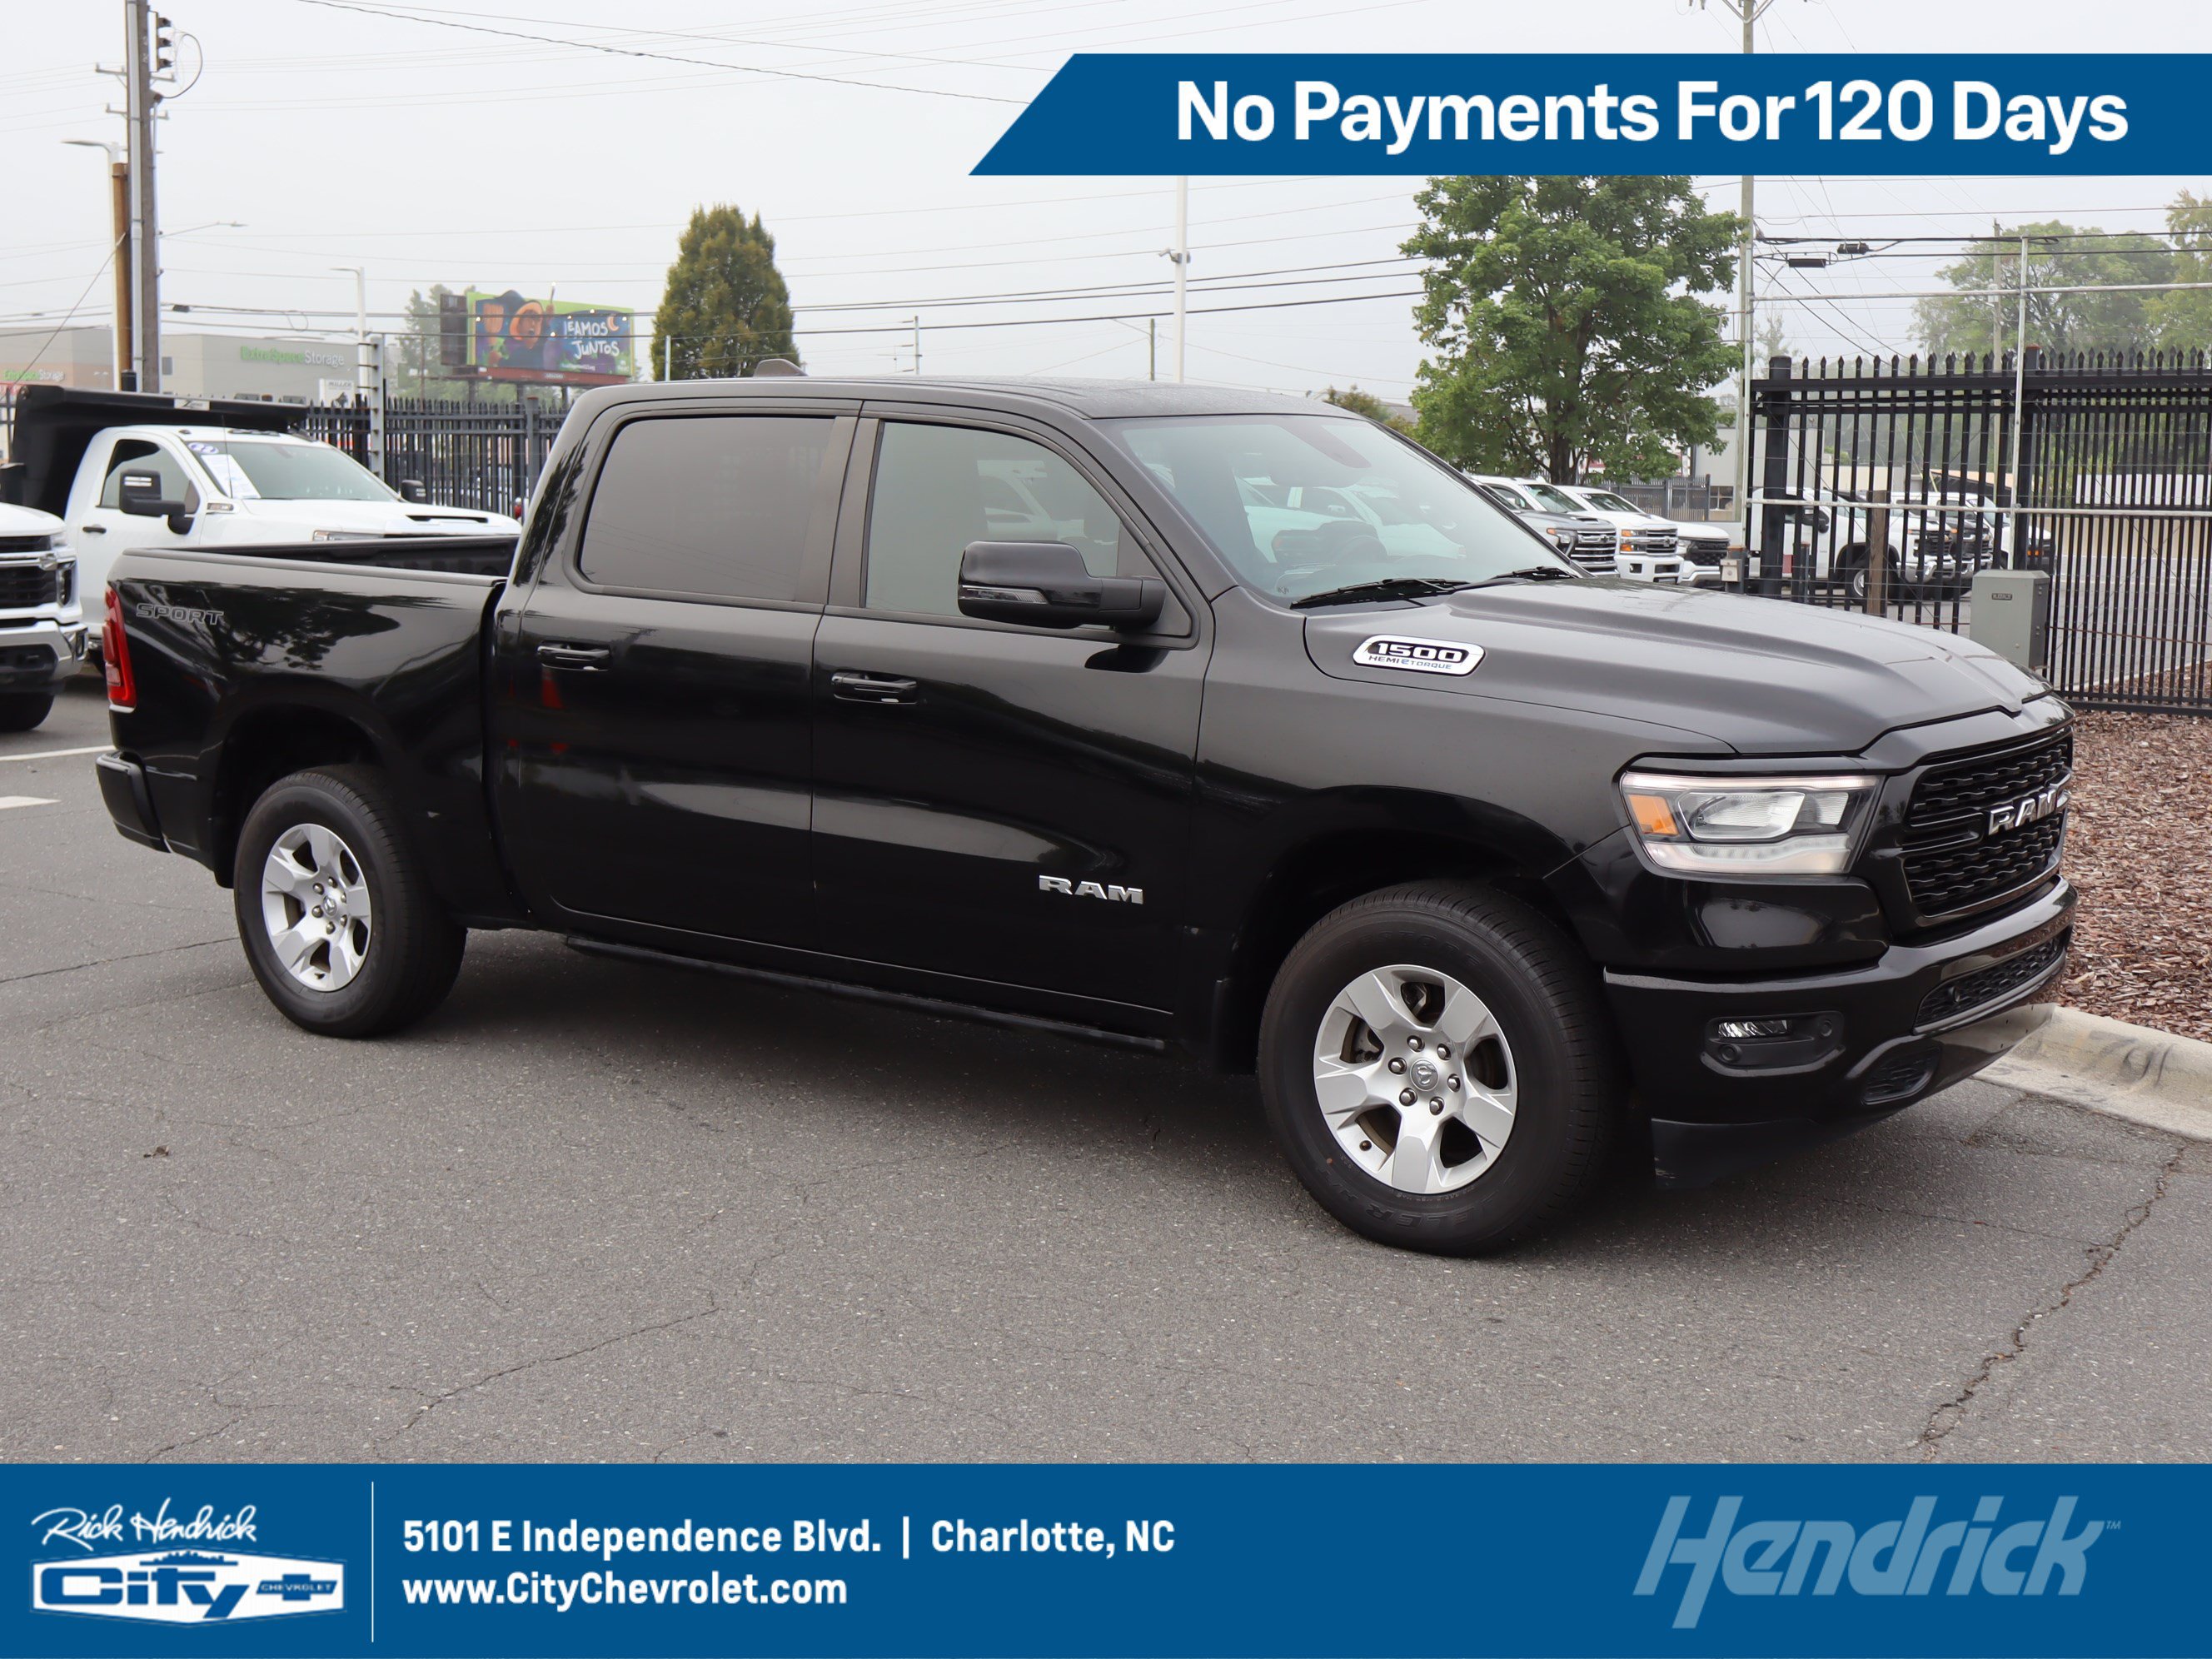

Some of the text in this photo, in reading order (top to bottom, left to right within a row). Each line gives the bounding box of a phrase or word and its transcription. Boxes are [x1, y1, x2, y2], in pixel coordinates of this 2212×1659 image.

[136, 602, 225, 625] SPORT
[1368, 655, 1400, 665] HEMI
[1378, 642, 1463, 663] 1500
[1988, 790, 2056, 836] RAM
[1039, 874, 1143, 905] RAM
